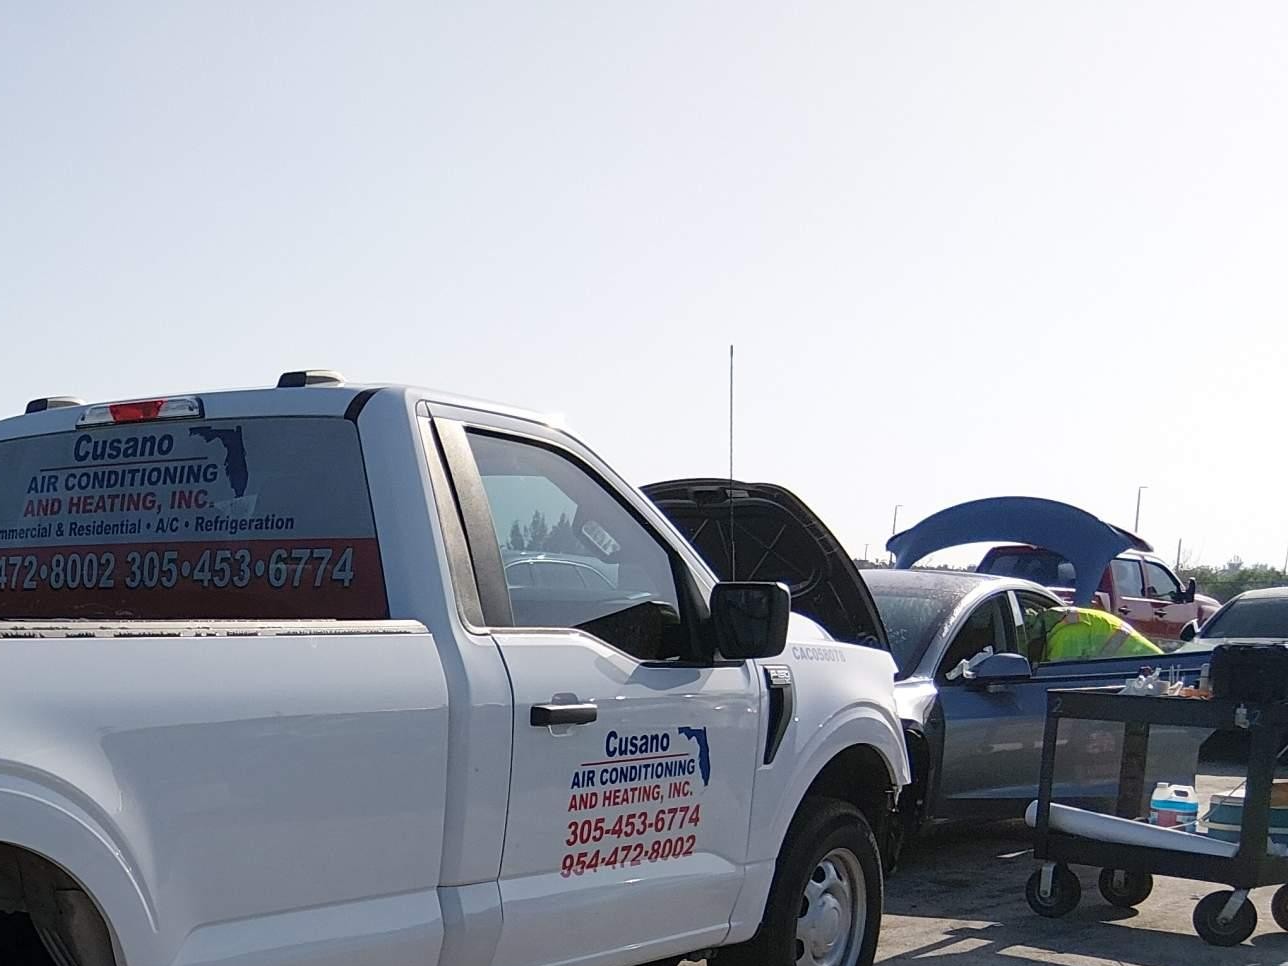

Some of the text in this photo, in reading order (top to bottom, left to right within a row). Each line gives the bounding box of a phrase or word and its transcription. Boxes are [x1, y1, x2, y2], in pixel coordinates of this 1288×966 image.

[73, 433, 174, 462] Cusano
[27, 463, 218, 494] AIR CONDITIONING
[23, 498, 62, 518] AND
[67, 491, 162, 514] HEATING,
[55, 522, 64, 537] &
[68, 518, 141, 538] Residential
[155, 516, 180, 534] A/C
[194, 513, 295, 535] Refrigeration
[605, 730, 670, 758] Cusano
[571, 758, 695, 790] AIR CONDITIONING
[568, 780, 693, 812] AND HEATING, INC.
[565, 804, 701, 847] 305-453-6774
